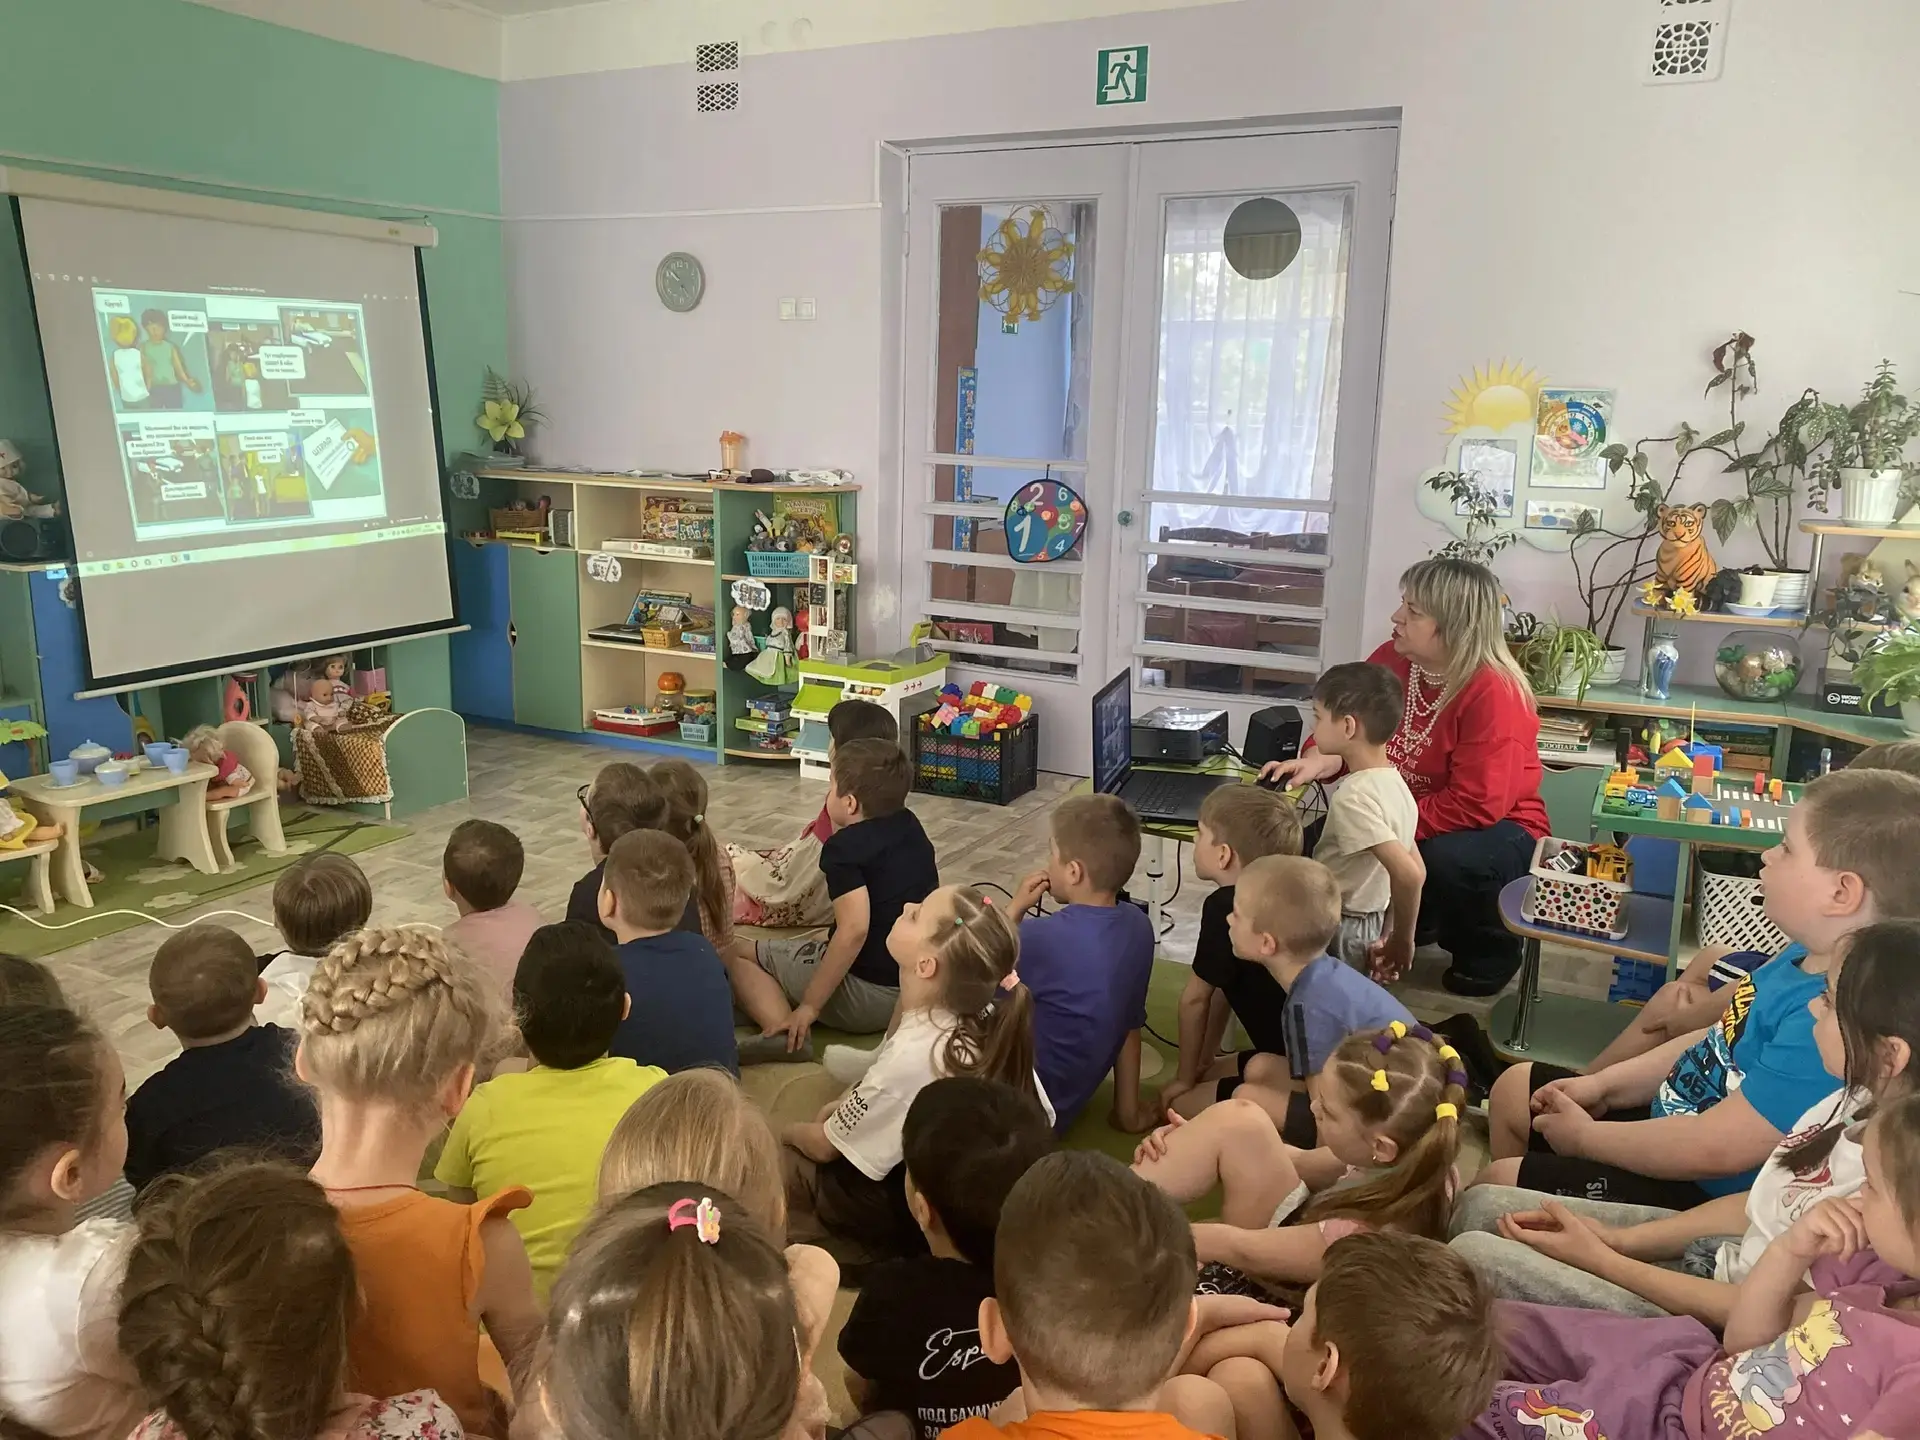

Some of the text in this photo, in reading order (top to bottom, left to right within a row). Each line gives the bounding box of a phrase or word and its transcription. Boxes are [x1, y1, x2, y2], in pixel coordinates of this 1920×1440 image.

[1028, 483, 1068, 506] 2 6
[1014, 514, 1032, 553] 1
[1075, 522, 1085, 533] 7
[1055, 539, 1066, 552] 4
[1037, 551, 1046, 560] 5
[1386, 744, 1405, 760] ake
[1543, 742, 1579, 751] ЗООПАРК
[918, 1407, 947, 1423] ПОД
